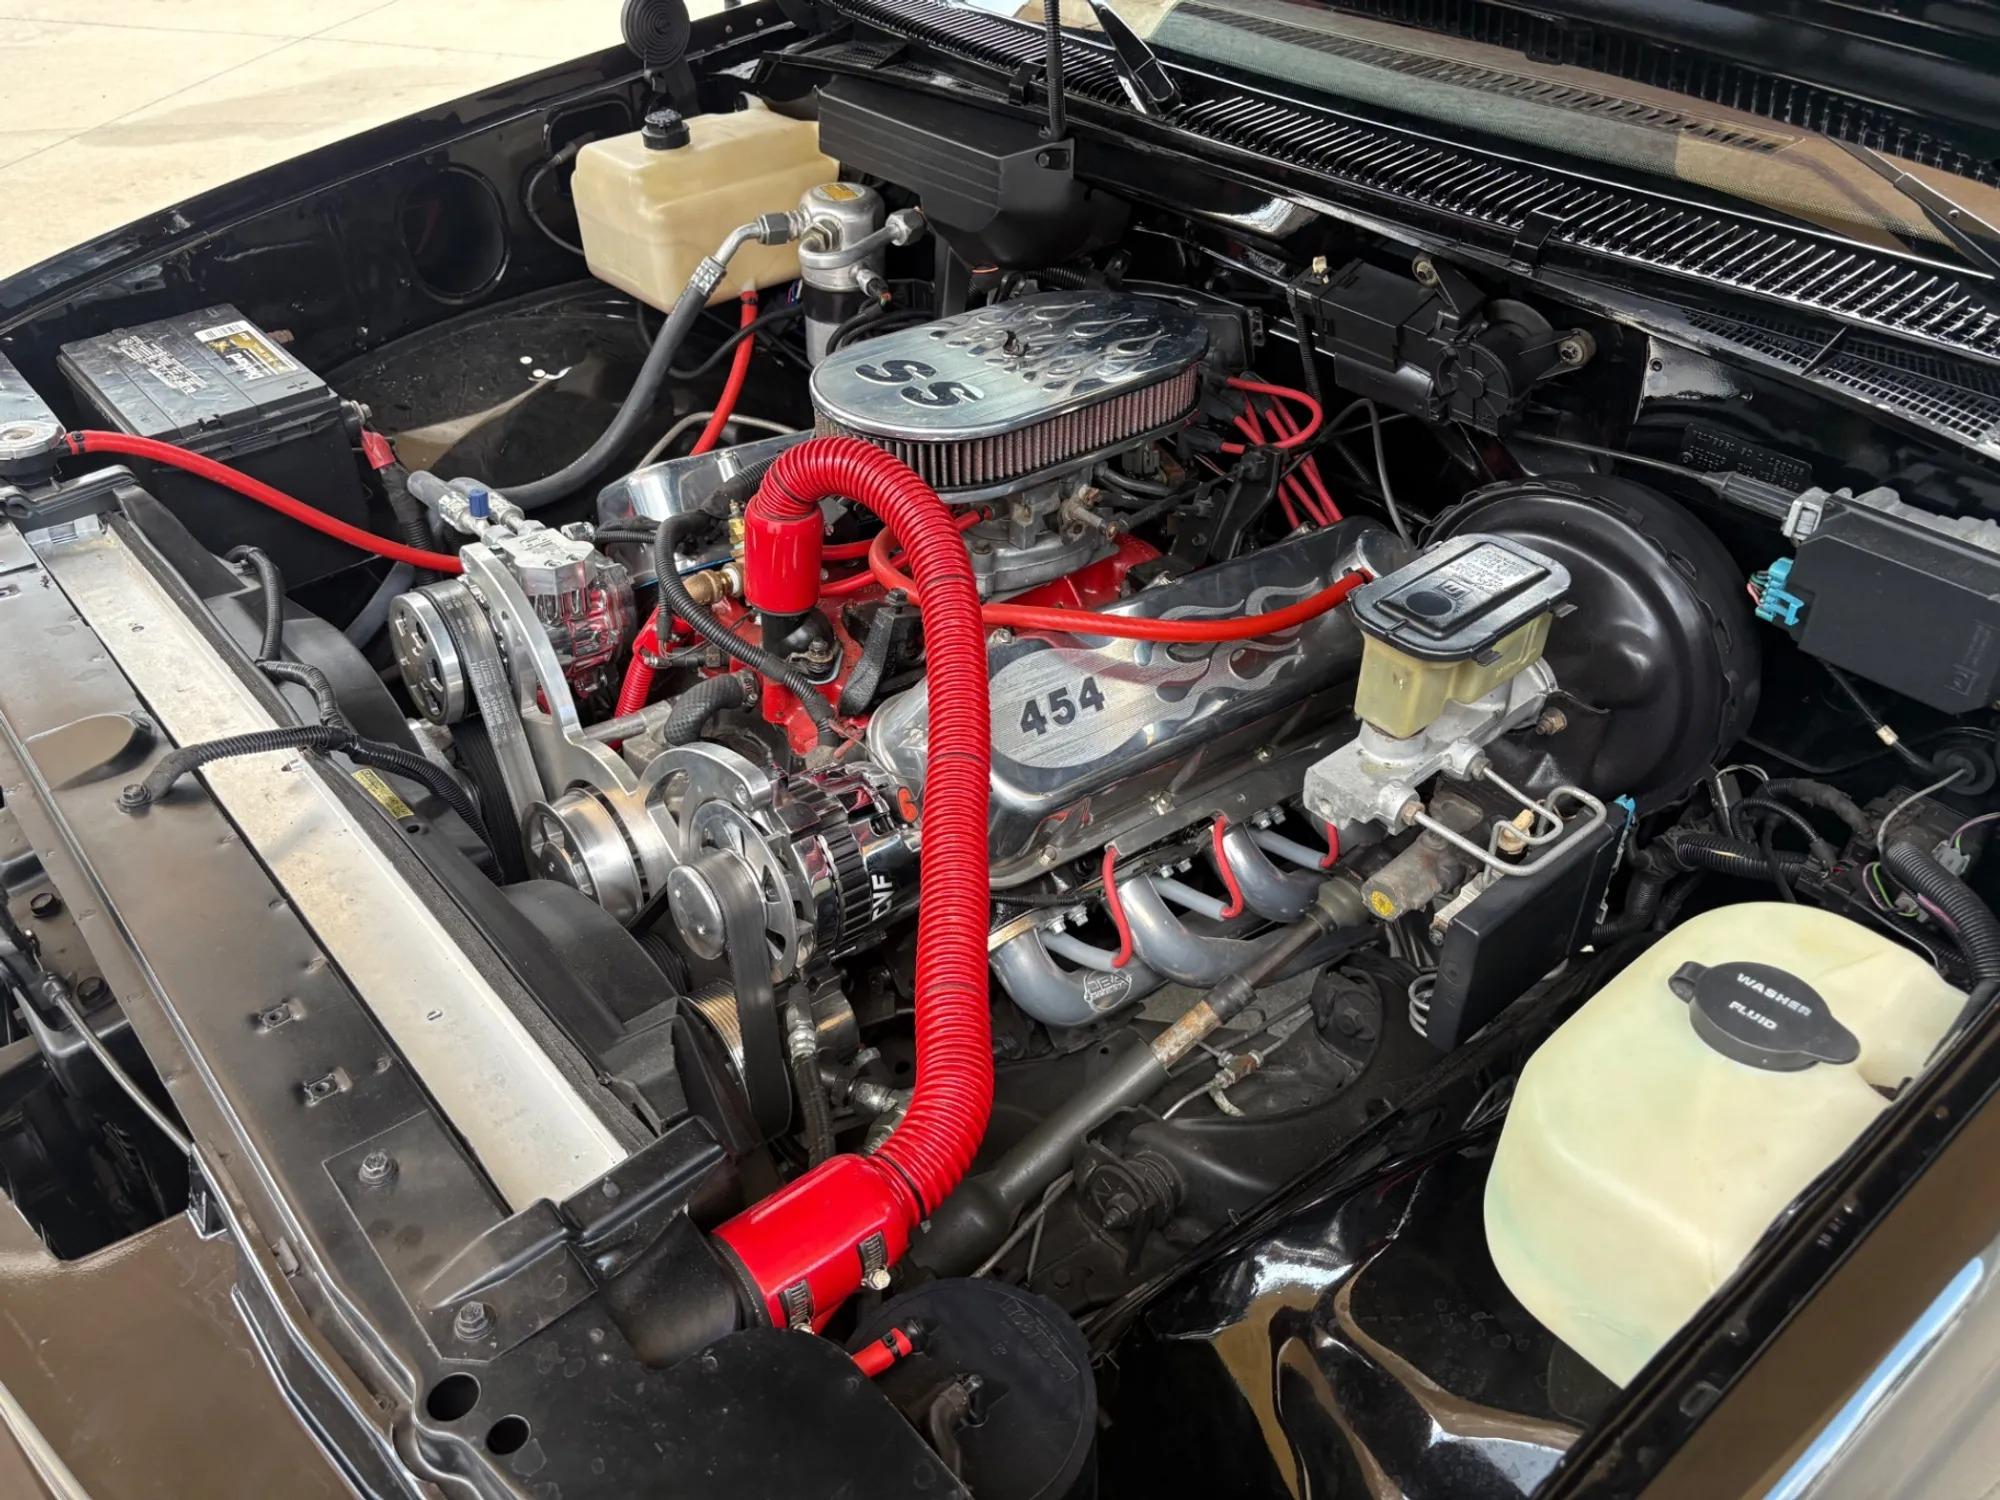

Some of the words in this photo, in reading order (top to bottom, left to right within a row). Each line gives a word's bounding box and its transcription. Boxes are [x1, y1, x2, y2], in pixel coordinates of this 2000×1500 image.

[855, 359, 985, 409] SS
[1020, 676, 1105, 736] 454
[870, 873, 896, 922] CVF
[1728, 1000, 1778, 1031] FLUID
[1736, 972, 1813, 1017] WASHER
